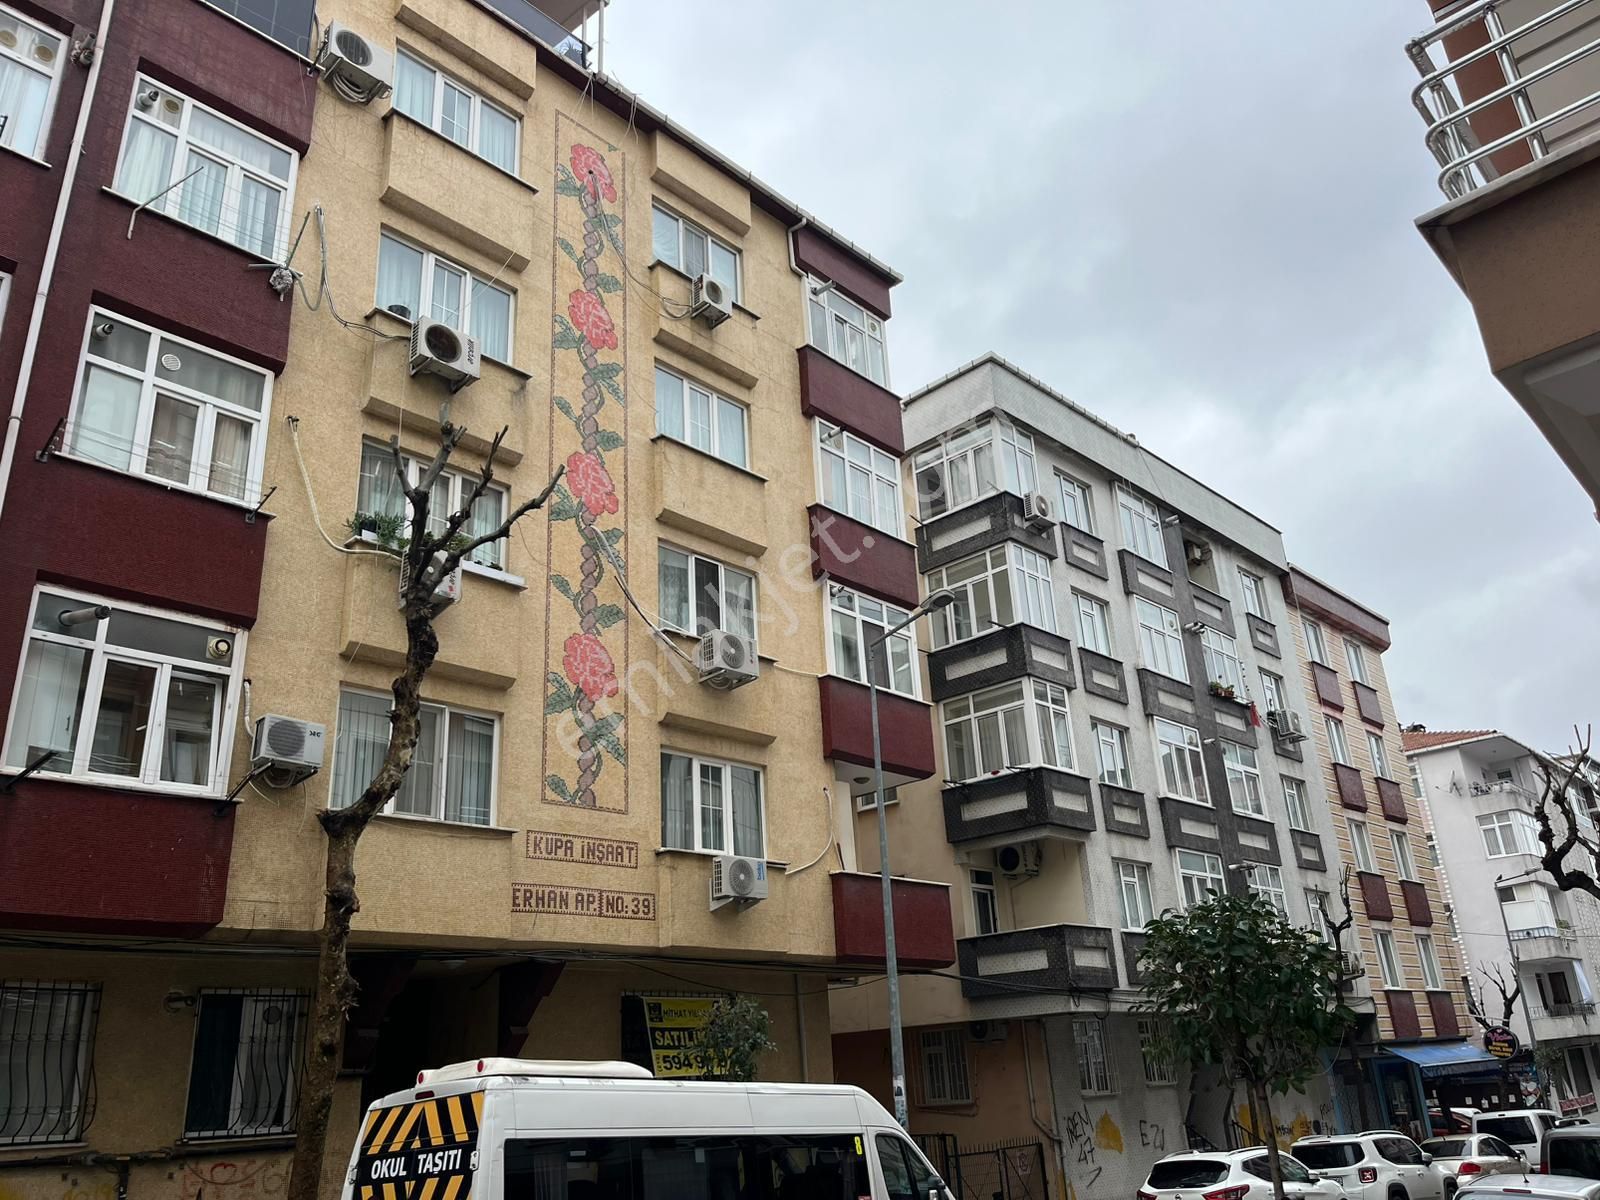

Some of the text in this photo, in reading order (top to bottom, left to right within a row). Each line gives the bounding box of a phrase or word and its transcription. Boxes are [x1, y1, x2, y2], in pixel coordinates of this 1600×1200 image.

[533, 835, 634, 864] KUPA İNŞAAT
[512, 888, 569, 910] ERHAN
[575, 892, 598, 913] AP.
[662, 1055, 693, 1071] 594
[371, 1149, 462, 1180] OKUL TAŞITI
